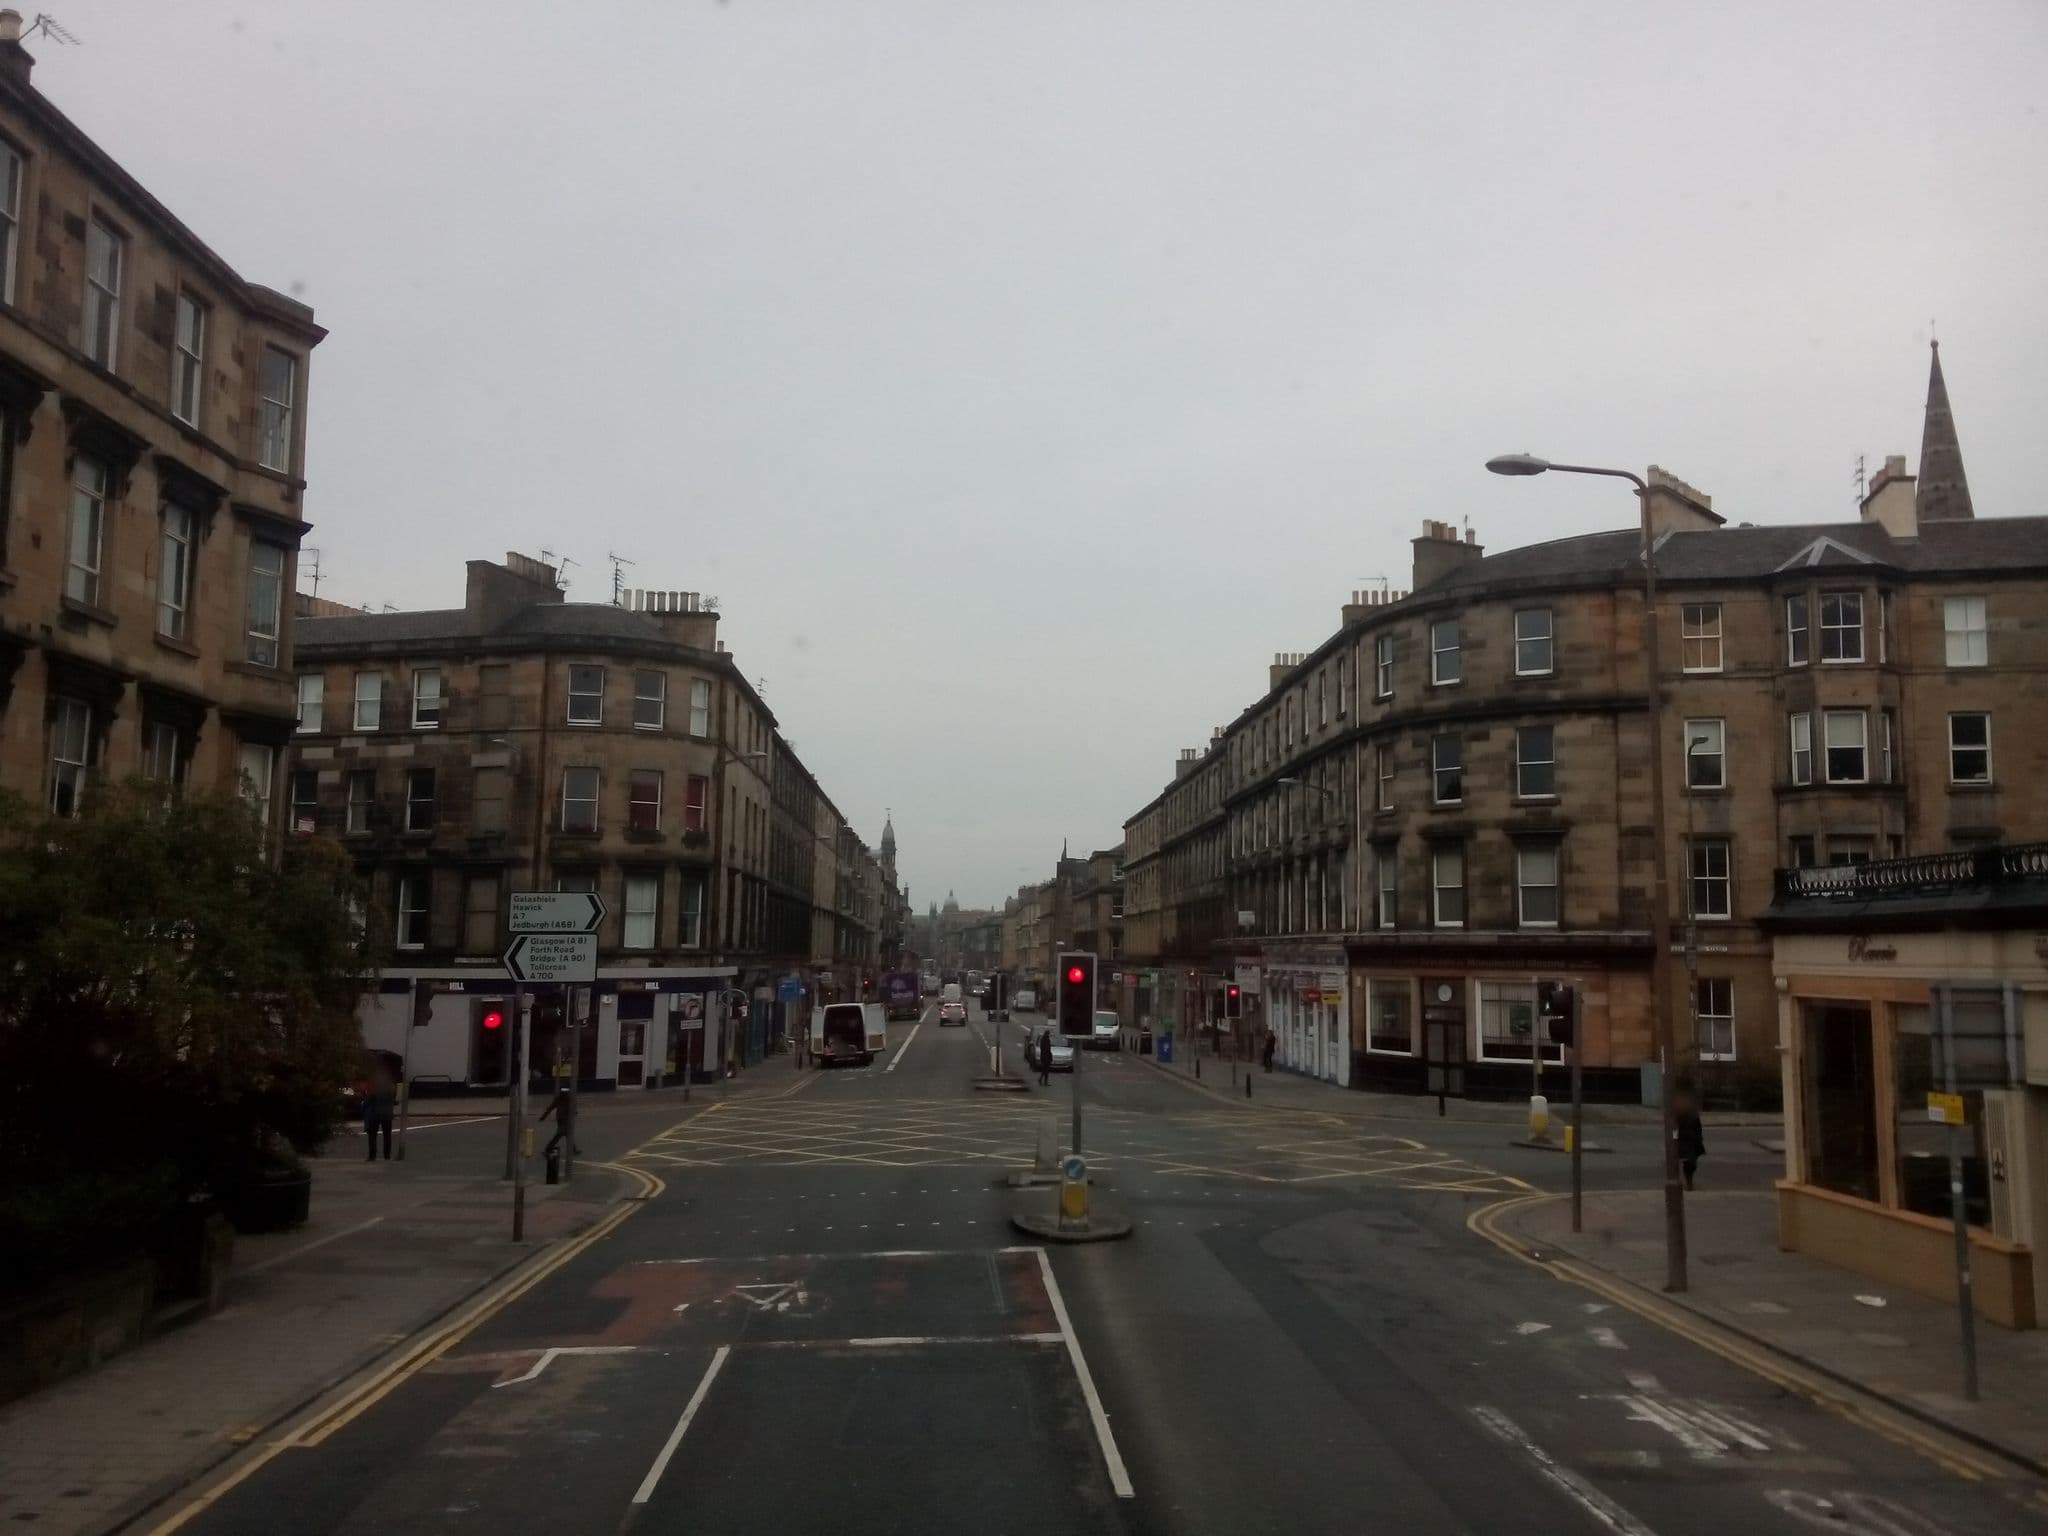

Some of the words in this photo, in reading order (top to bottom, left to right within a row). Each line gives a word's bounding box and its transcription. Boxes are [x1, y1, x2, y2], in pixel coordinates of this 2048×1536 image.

[513, 895, 556, 903] Galashiels
[512, 920, 550, 929] Jedburgh
[530, 937, 565, 945] Glasgow
[530, 954, 557, 962] Bridge
